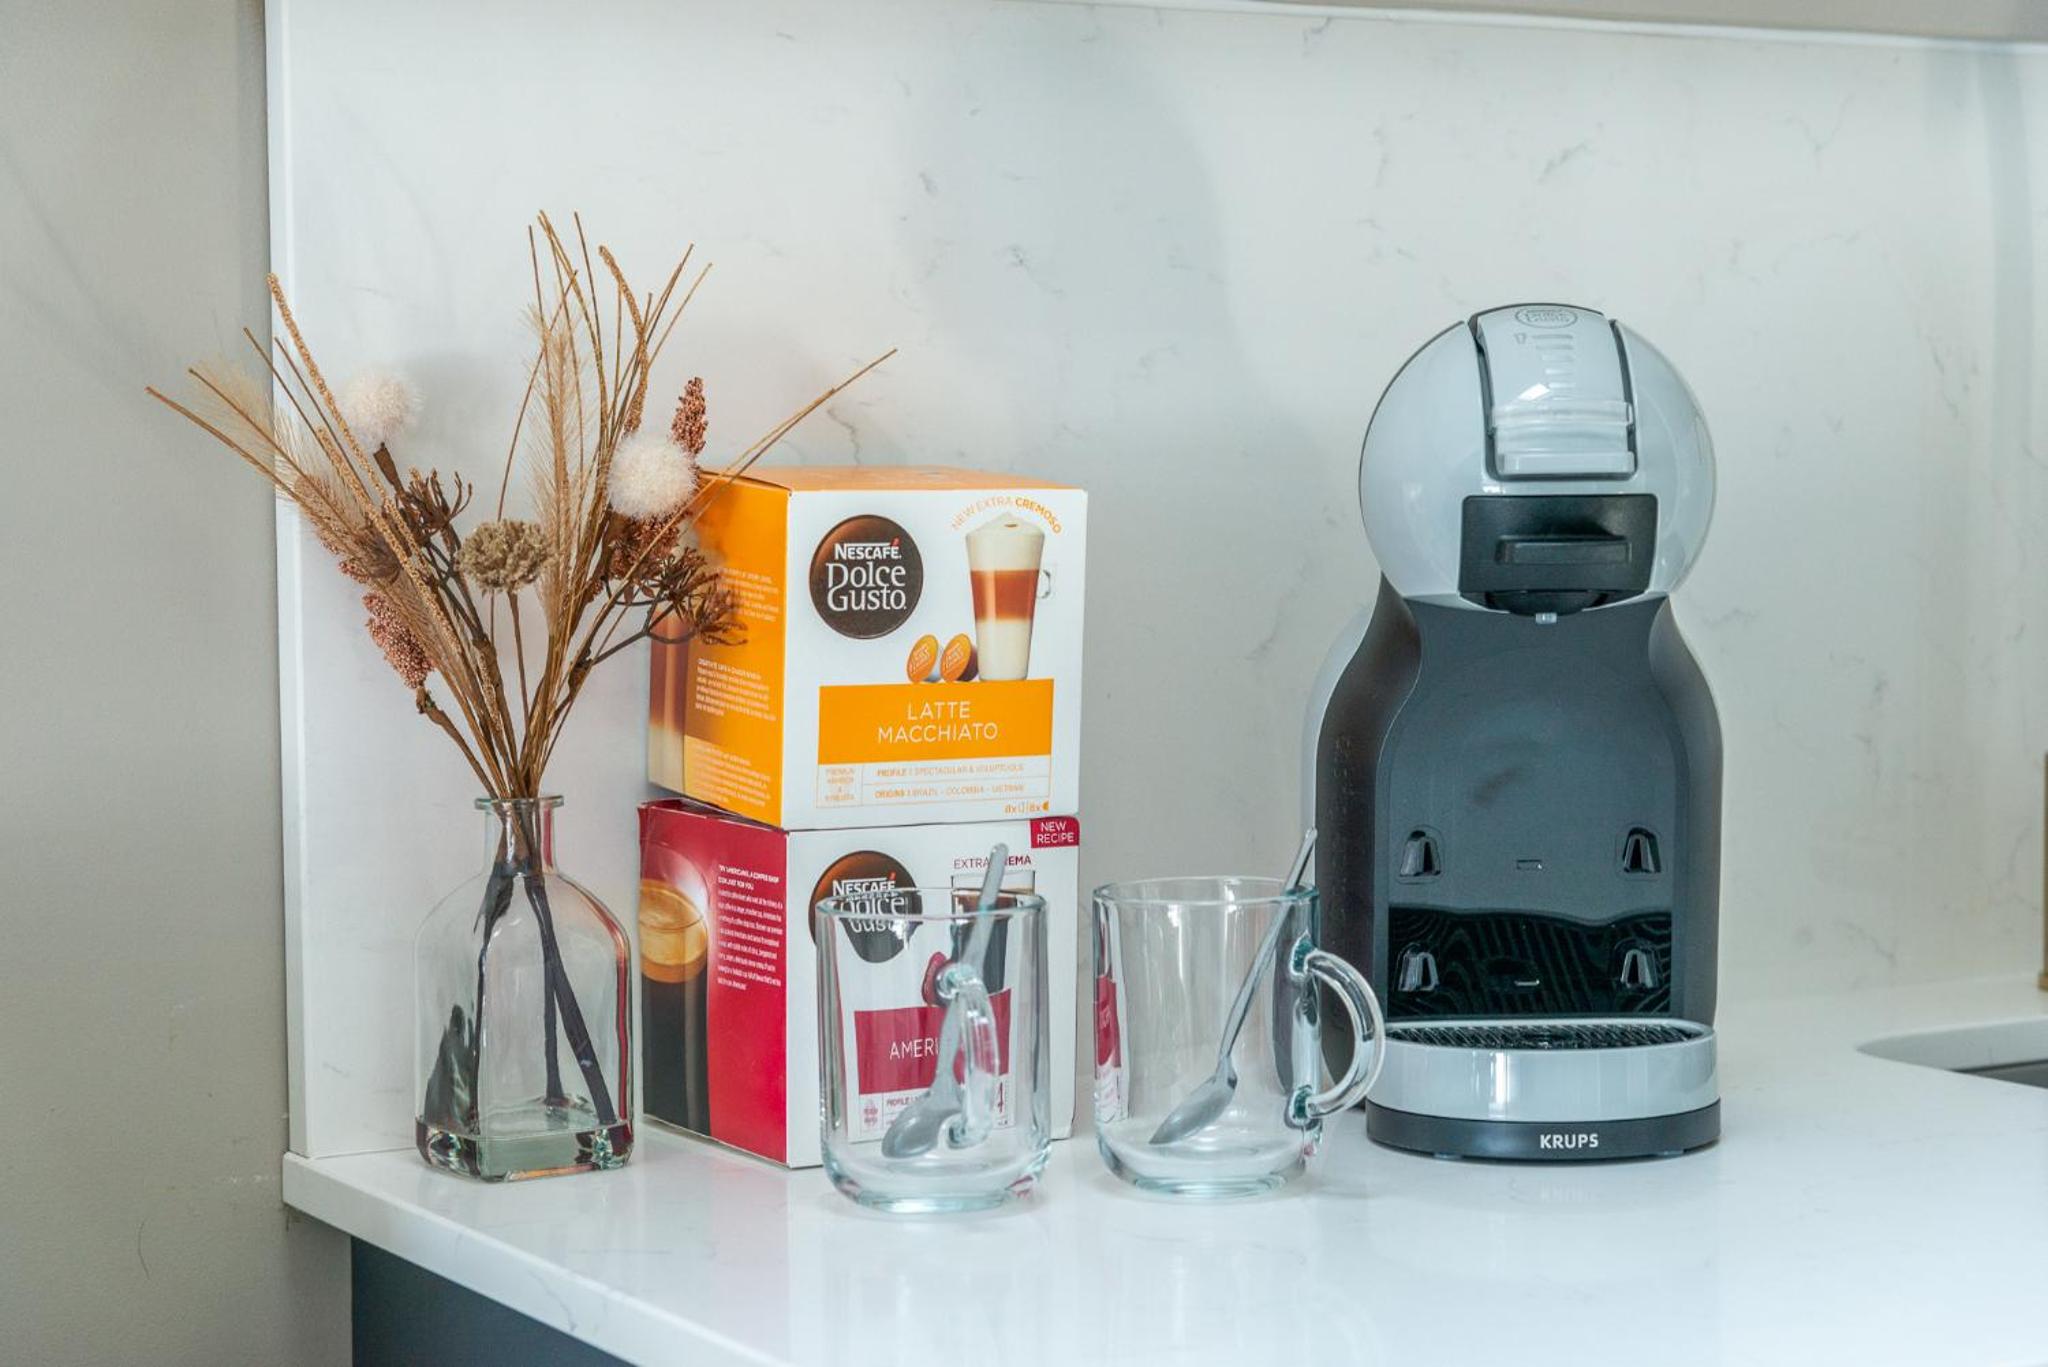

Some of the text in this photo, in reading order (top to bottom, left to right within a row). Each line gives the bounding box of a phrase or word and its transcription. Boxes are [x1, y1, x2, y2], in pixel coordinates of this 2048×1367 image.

[1015, 496, 1063, 535] CREMOSO
[826, 561, 906, 590] Dolce
[827, 586, 906, 612] Gusto
[907, 701, 971, 720] LATTE
[878, 722, 999, 743] MACCHIATO
[1041, 821, 1067, 832] NEW
[1037, 832, 1075, 845] RECIPE
[953, 855, 1032, 870] EXTRA EMA
[889, 1037, 939, 1060] AMERI
[1539, 1133, 1600, 1149] KRUPS
